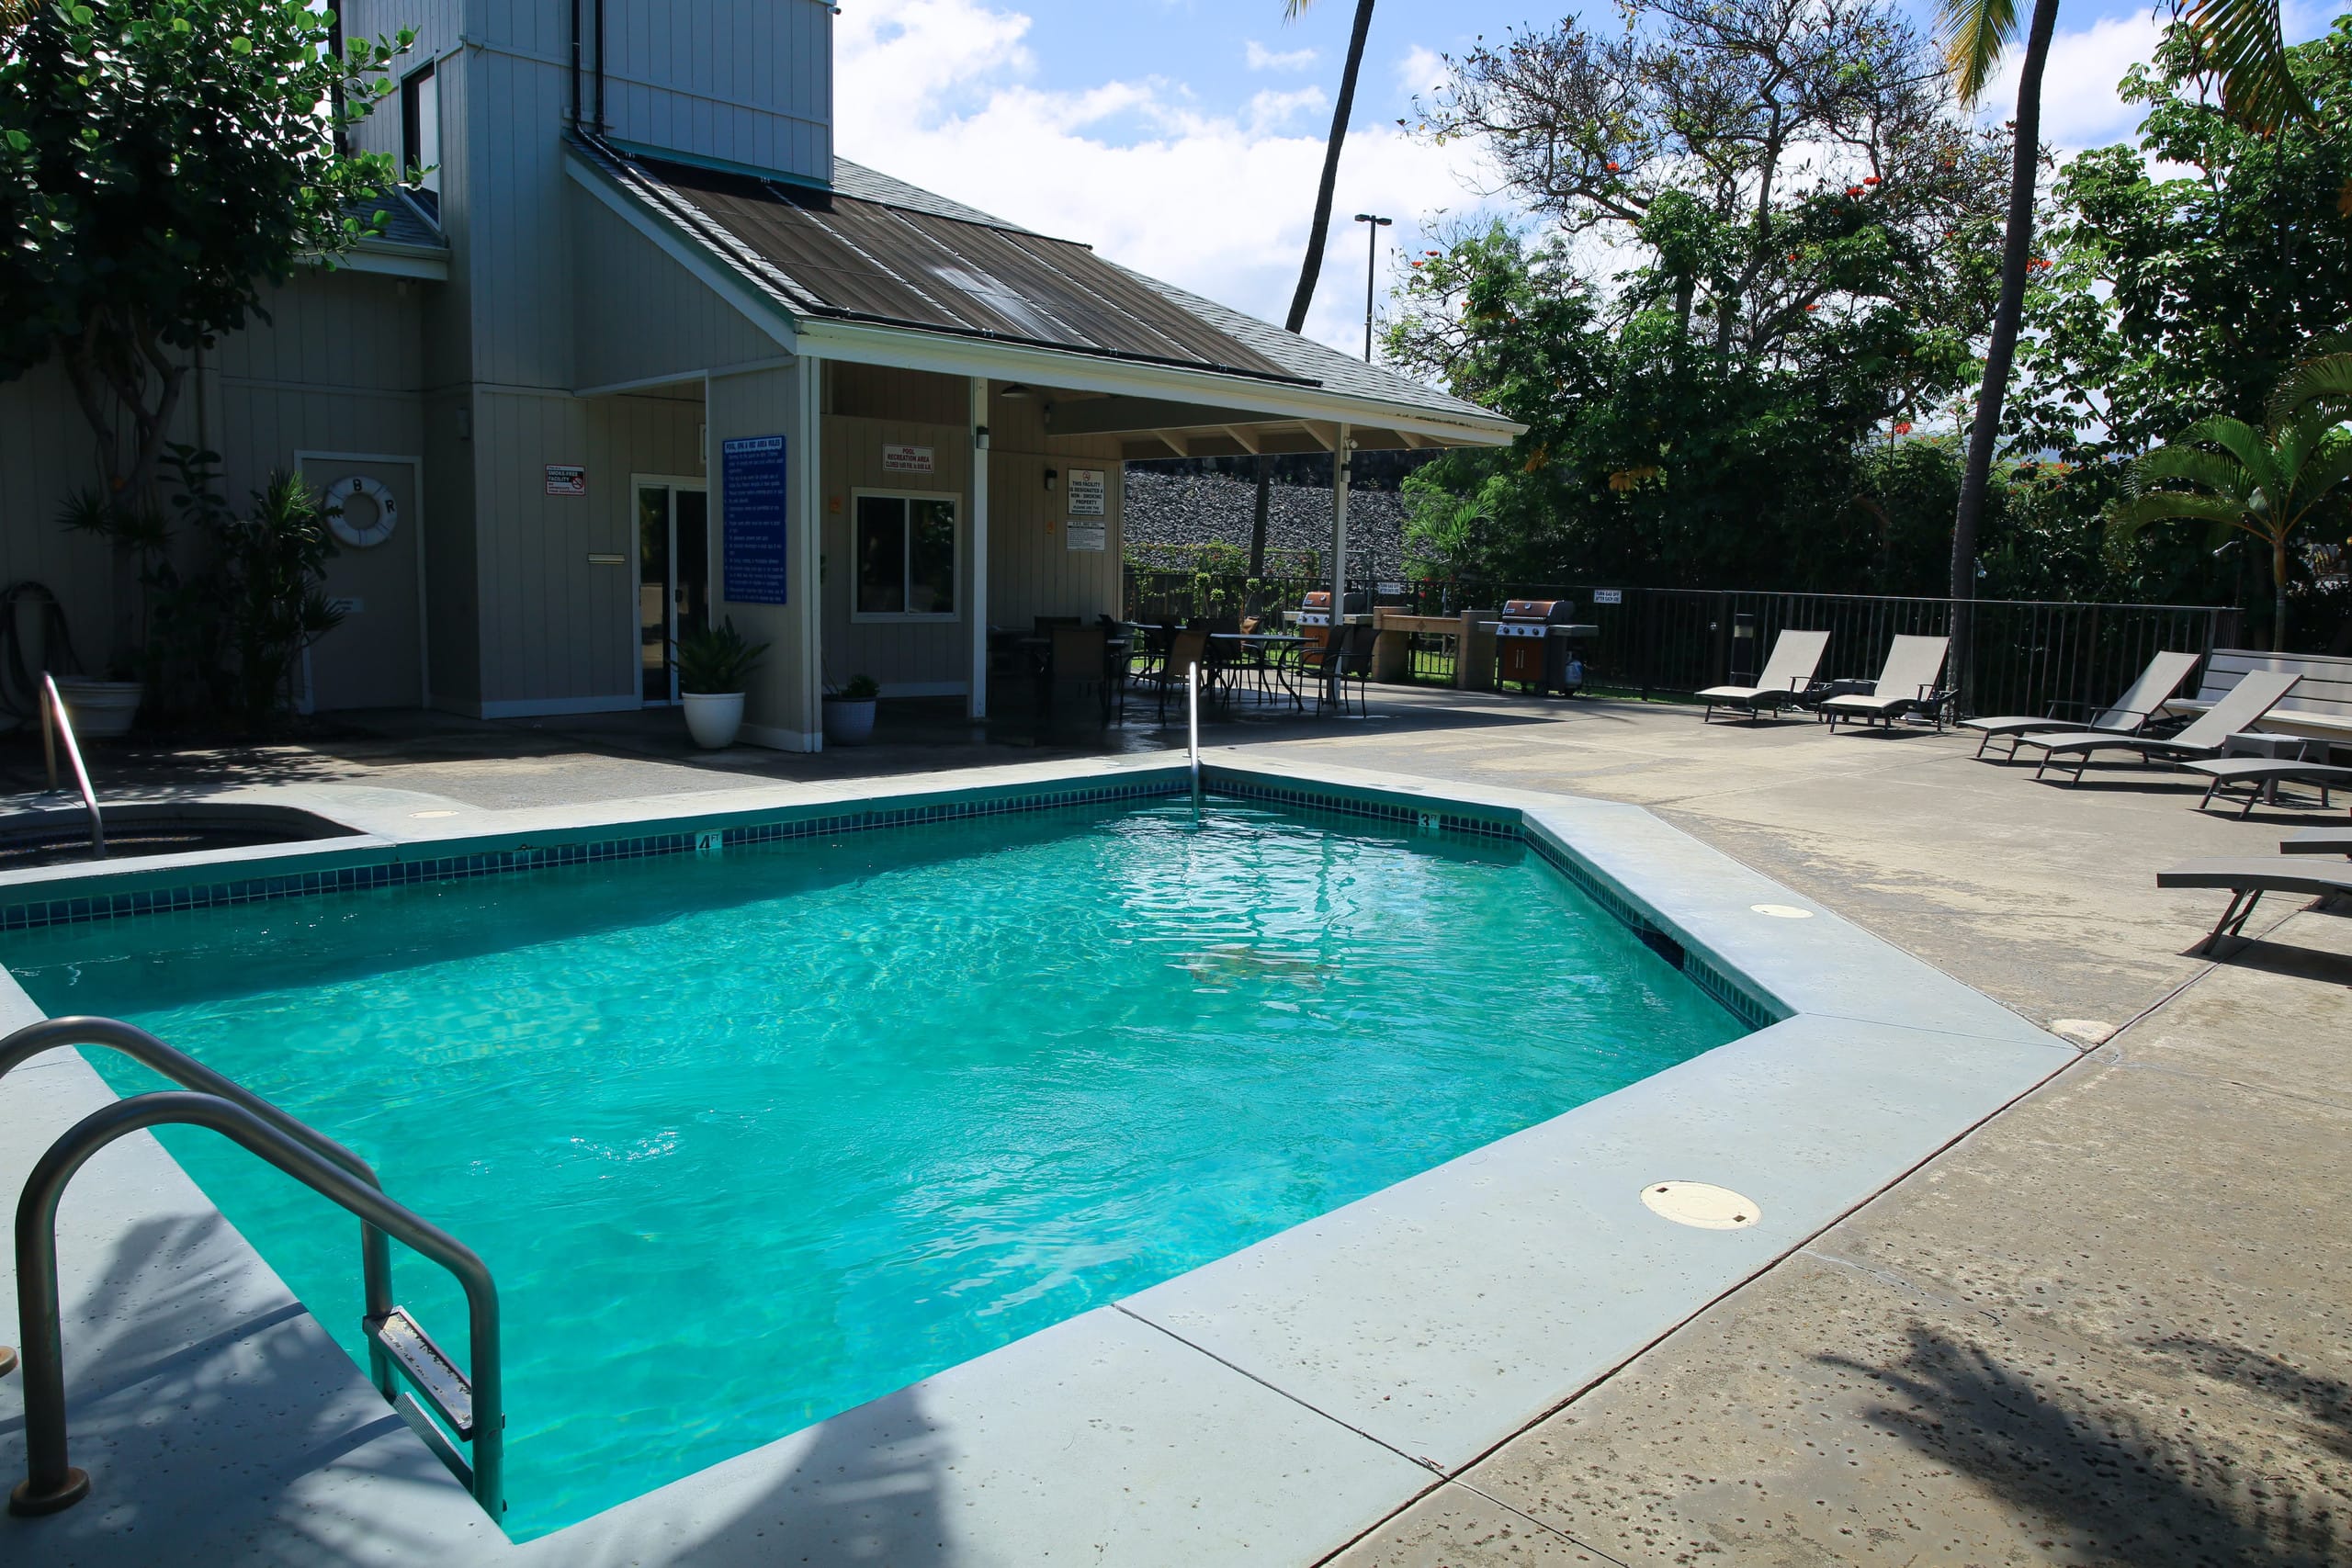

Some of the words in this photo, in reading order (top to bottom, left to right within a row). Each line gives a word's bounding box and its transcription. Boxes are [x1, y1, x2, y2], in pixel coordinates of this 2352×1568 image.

[757, 440, 767, 448] AREA
[768, 439, 781, 447] RULES
[353, 479, 363, 491] B
[385, 500, 395, 513] R
[1420, 813, 1430, 826] 3
[699, 834, 710, 849] 4
